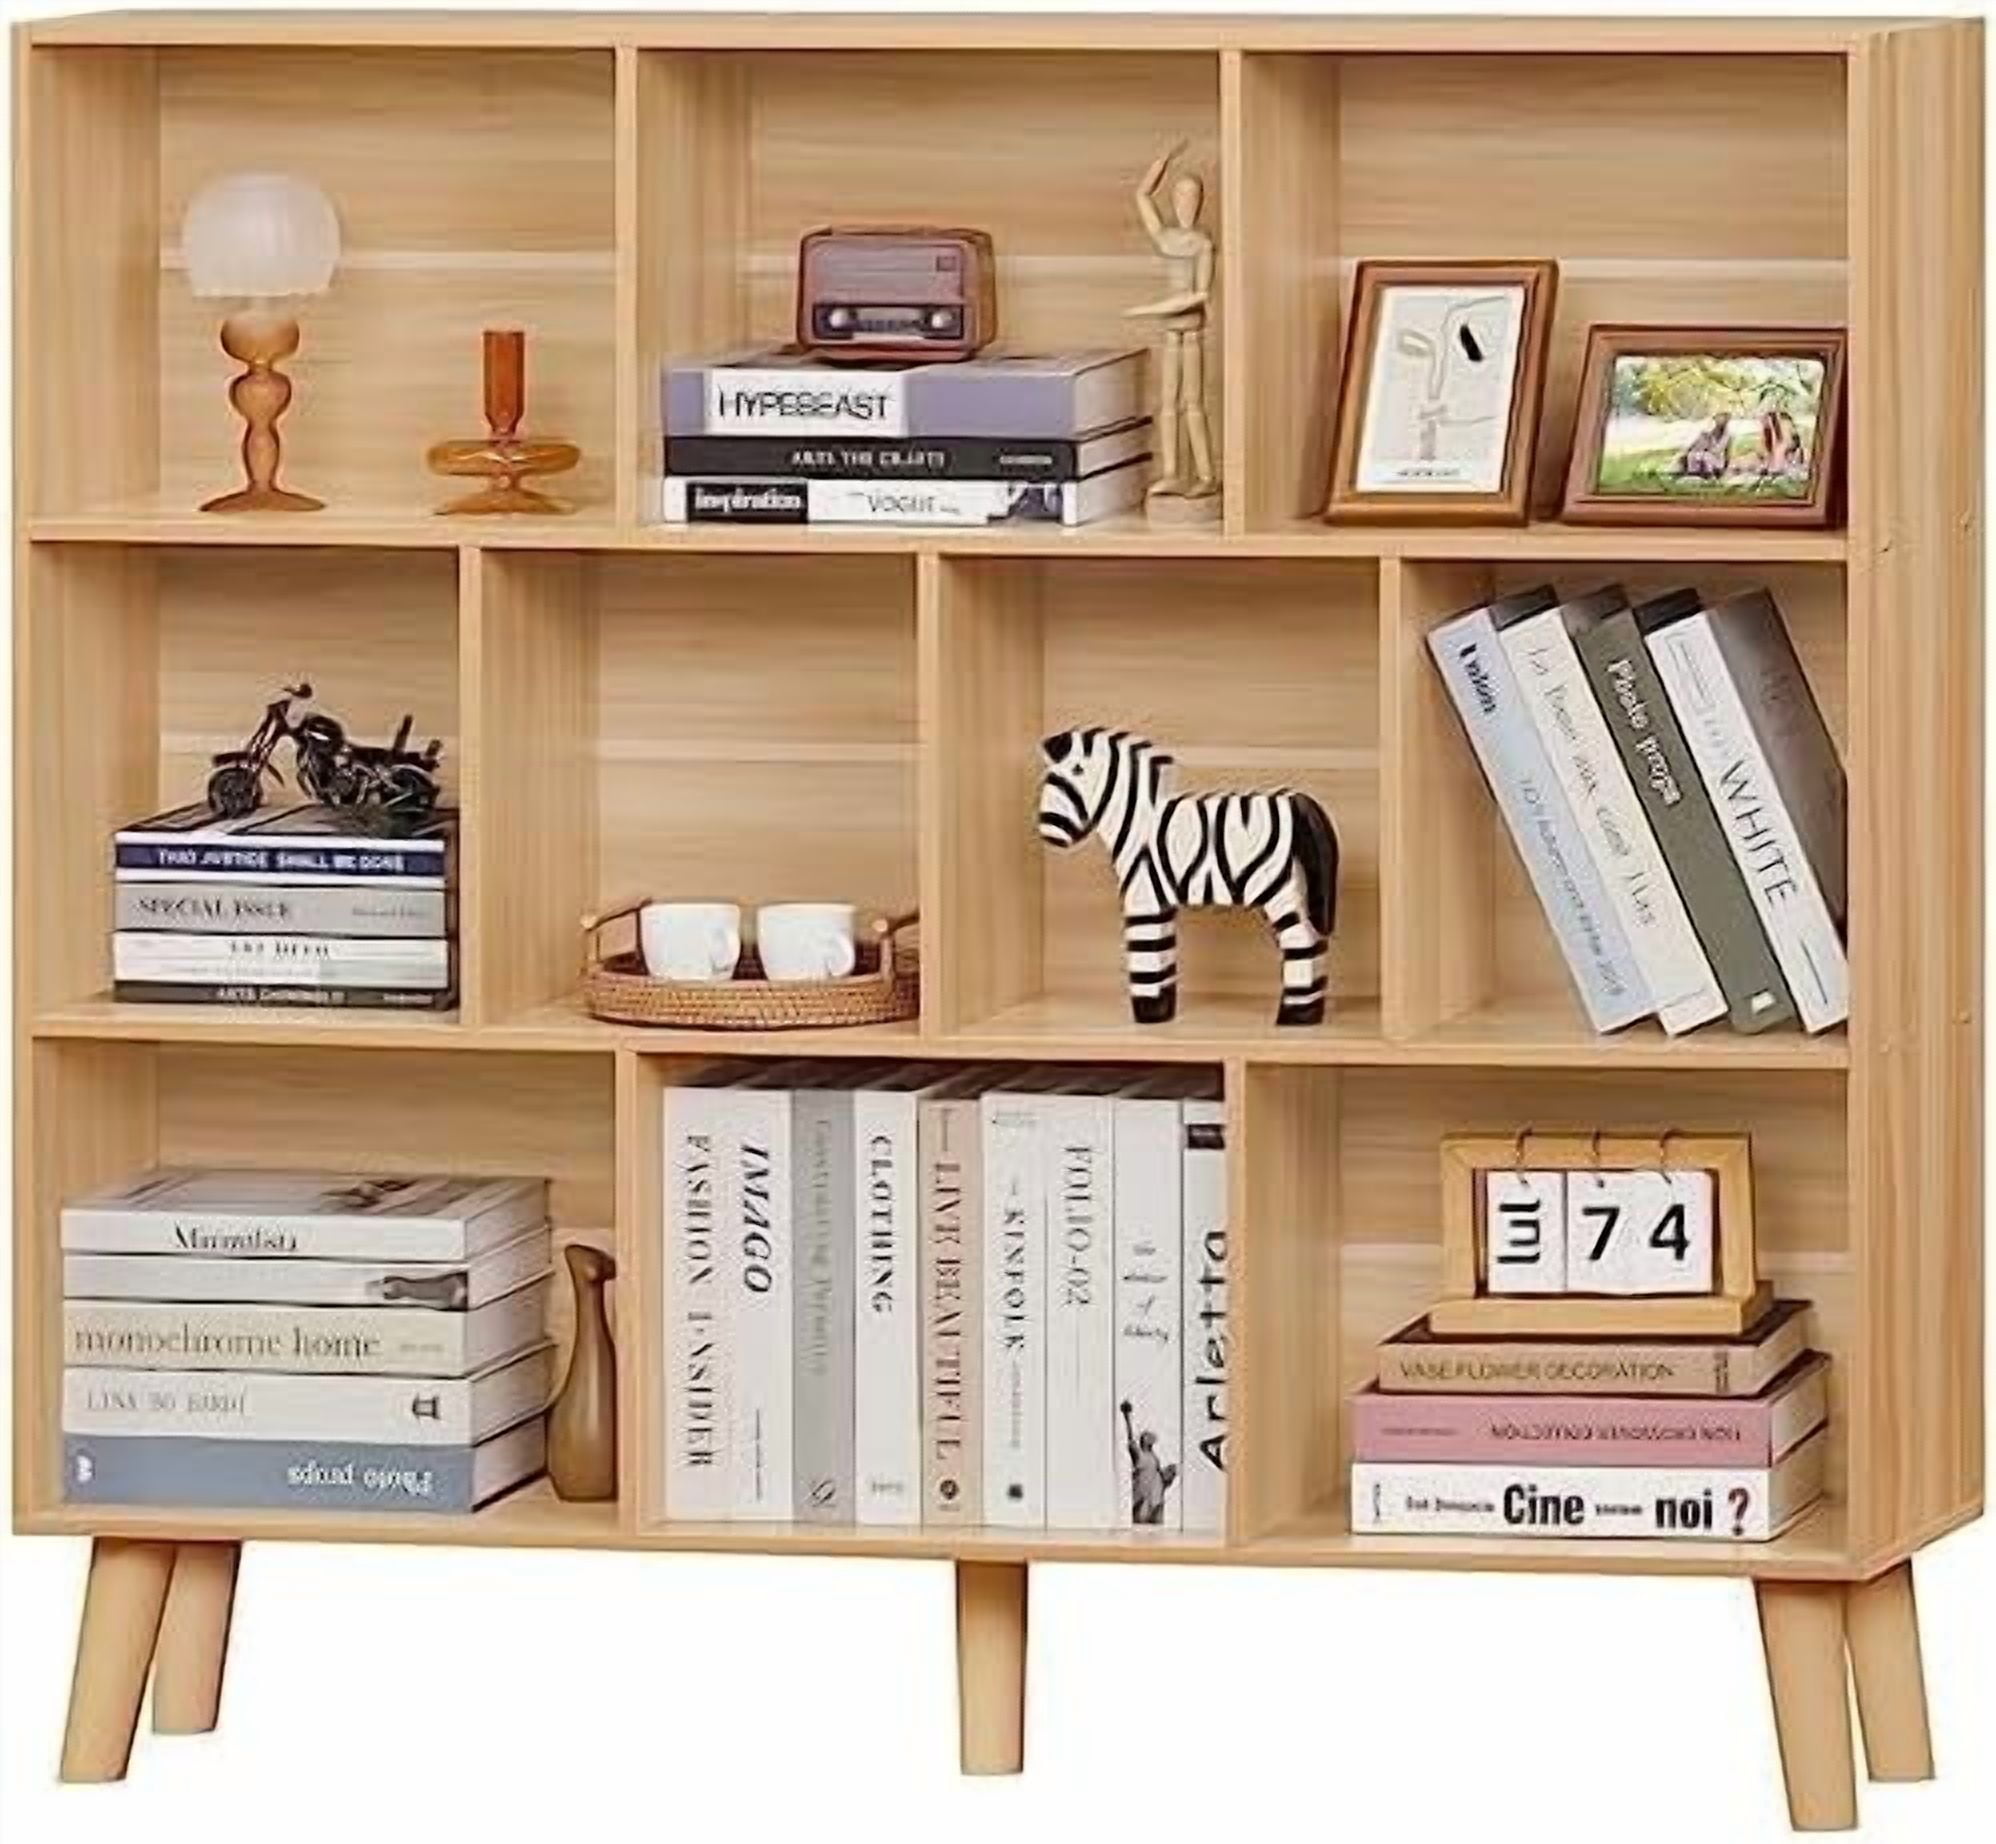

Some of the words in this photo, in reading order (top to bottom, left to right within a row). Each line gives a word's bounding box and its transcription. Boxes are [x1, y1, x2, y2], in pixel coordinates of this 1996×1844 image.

[718, 388, 890, 420] HYPEBEAST
[1719, 760, 1798, 908] WHITE
[740, 1143, 773, 1293] IMAGO
[869, 1135, 893, 1314] CLOTHING
[933, 1163, 962, 1244] LIVE
[1063, 1146, 1093, 1306] FOLIO-02
[1003, 1208, 1026, 1348] KINFOLK
[75, 1323, 282, 1357] monochrome
[292, 1326, 382, 1363] home
[933, 1259, 962, 1460] BEAUTIFUL
[1400, 1361, 1449, 1381] VASE
[287, 1459, 355, 1487] props
[363, 1471, 434, 1497] Photo
[1502, 1483, 1585, 1527] Cine
[1655, 1488, 1713, 1530] noi
[1727, 1487, 1751, 1536] ?
